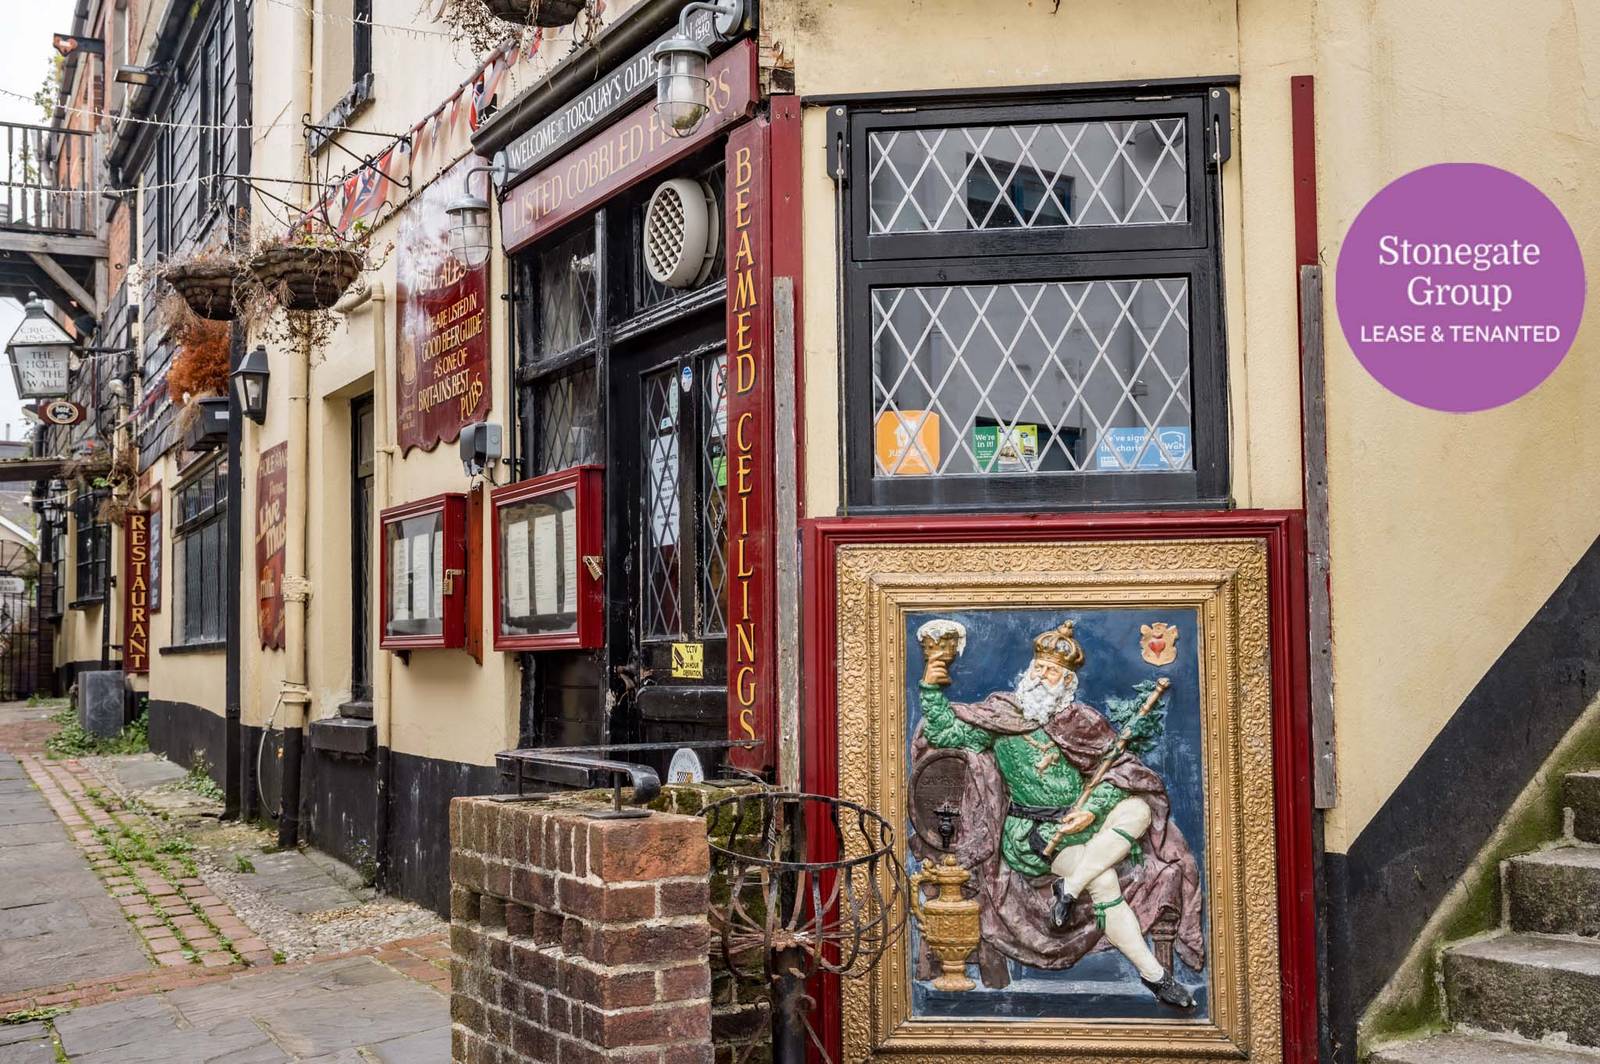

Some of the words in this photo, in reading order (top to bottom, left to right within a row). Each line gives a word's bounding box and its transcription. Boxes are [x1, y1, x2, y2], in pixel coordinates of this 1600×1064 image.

[695, 21, 711, 41] 1540
[511, 119, 557, 169] WELCOME
[624, 49, 660, 92] OLDE
[512, 174, 564, 234] LISTED
[566, 123, 645, 200] COBBLED
[648, 67, 731, 152] FLRS
[439, 259, 467, 289] ALES
[733, 146, 758, 395] BEAMED
[448, 296, 469, 323] LISTED
[469, 292, 478, 312] IN
[441, 325, 462, 352] BEER
[26, 360, 60, 369] HOLE
[31, 351, 54, 360] THE
[433, 359, 443, 379] AS
[442, 352, 457, 375] ONE
[457, 347, 468, 367] OF
[22, 370, 35, 379] IN
[42, 370, 65, 379] THE
[26, 380, 65, 388] WALL
[451, 368, 470, 398] BEST
[460, 372, 484, 421] PUBS
[129, 515, 147, 668] RESTAURANT
[736, 412, 757, 750] CEILINGS
